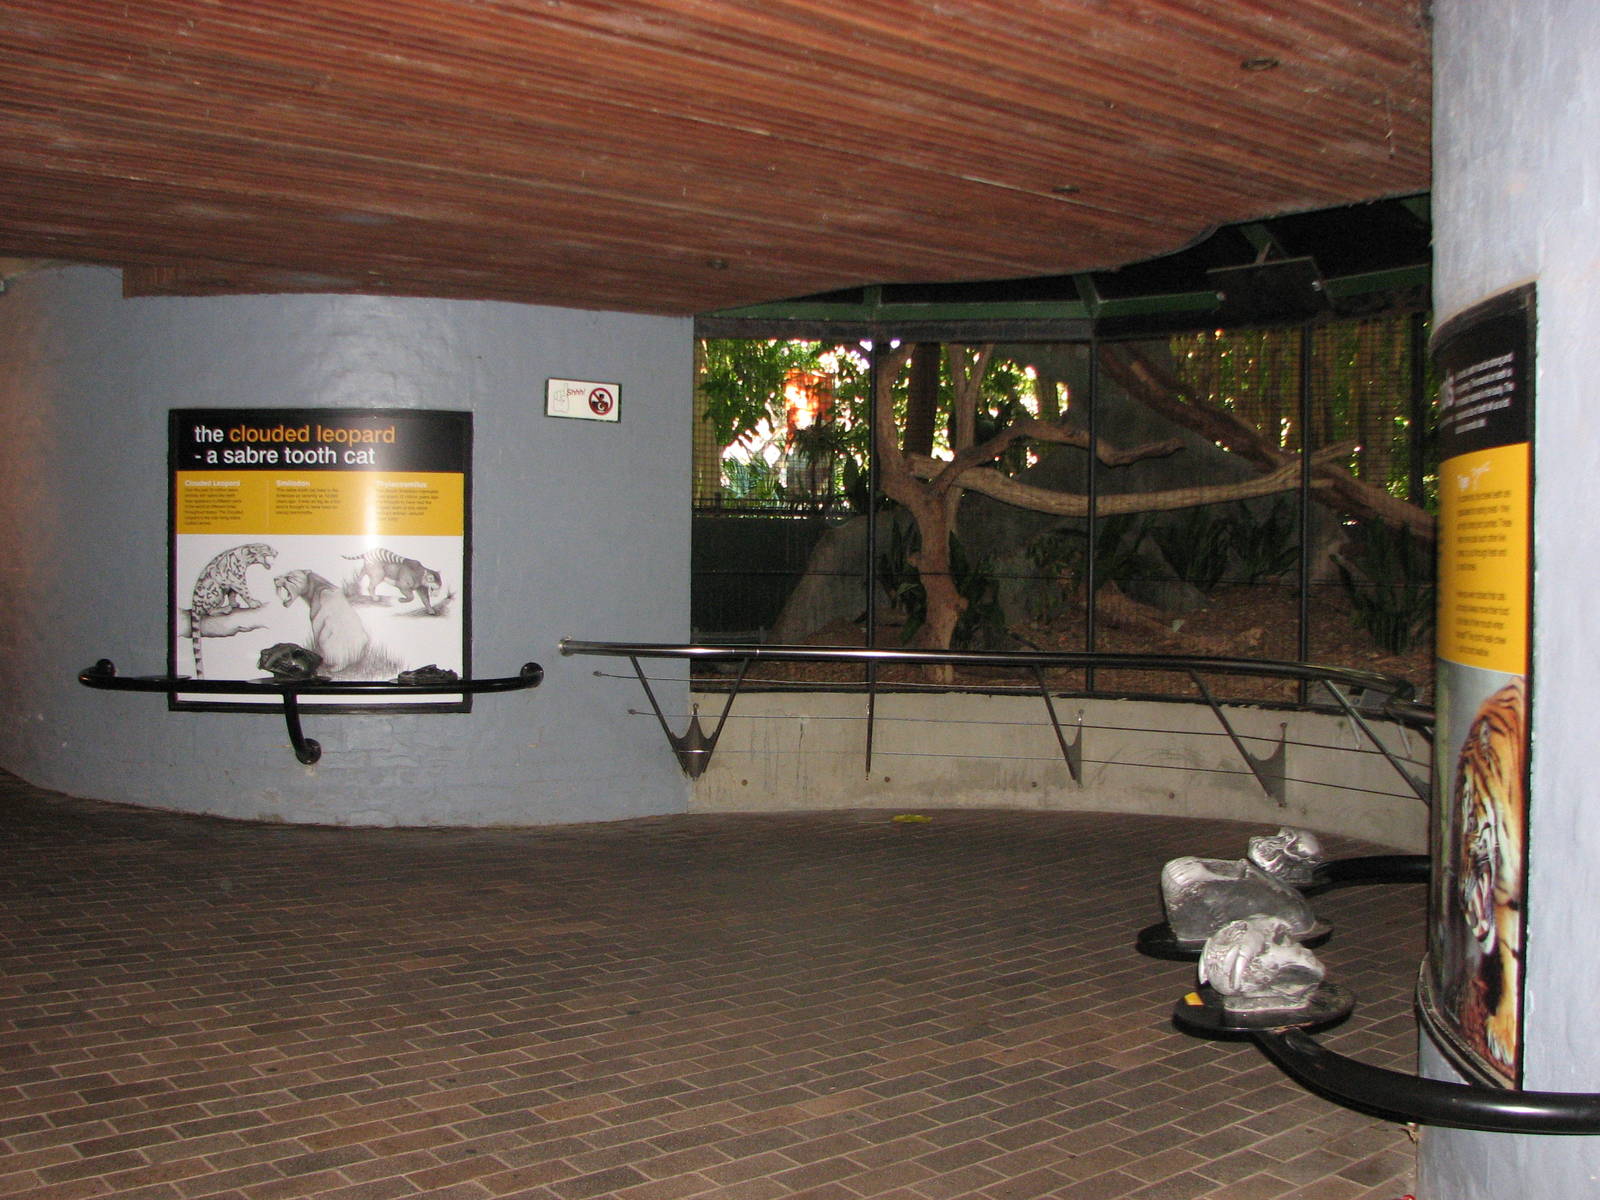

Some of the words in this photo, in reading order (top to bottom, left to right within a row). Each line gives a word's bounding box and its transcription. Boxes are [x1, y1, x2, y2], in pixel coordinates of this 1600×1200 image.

[194, 425, 224, 443] the
[228, 425, 310, 443] clouded
[316, 425, 396, 447] leopard
[206, 450, 218, 464] a
[223, 446, 279, 464] sabre
[284, 447, 337, 464] tooth
[343, 447, 376, 465] cat
